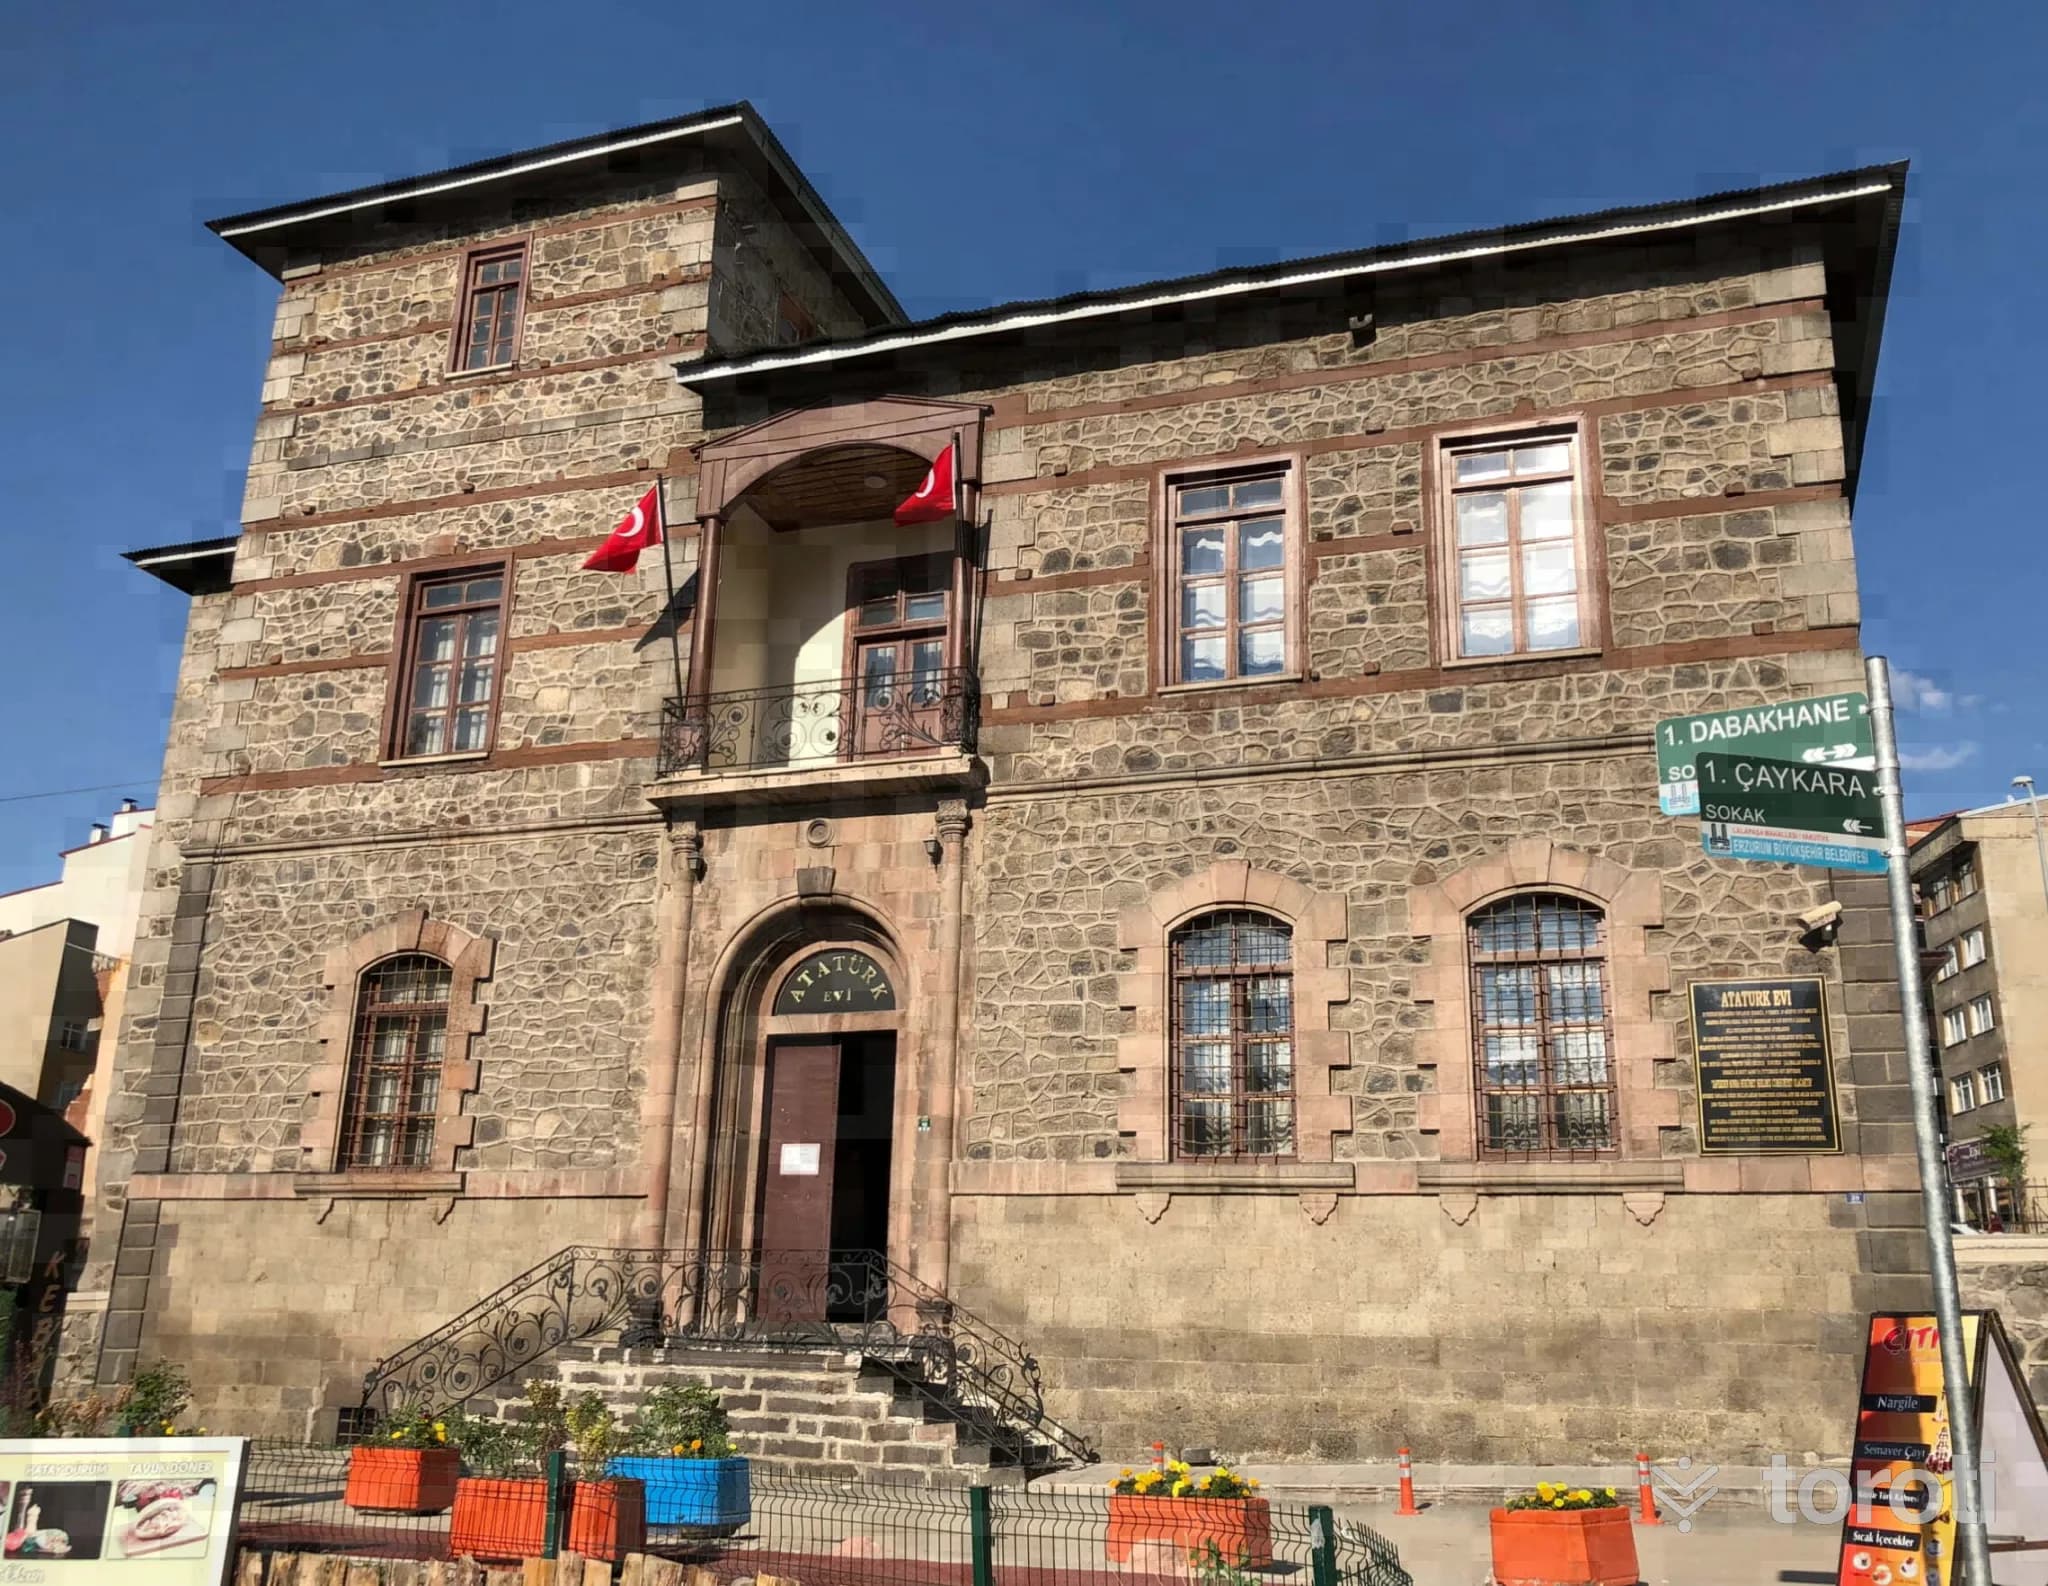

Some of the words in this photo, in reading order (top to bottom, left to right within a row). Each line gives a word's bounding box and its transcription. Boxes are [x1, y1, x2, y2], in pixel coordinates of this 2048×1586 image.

[1664, 725, 1684, 746] 1.
[1690, 699, 1851, 743] DABAKHANE
[1704, 760, 1726, 784] 1.
[1735, 763, 1867, 798] ÇAYKARA
[1706, 804, 1767, 824] SOKAK
[1733, 839, 1772, 854] ERZURUM
[1773, 840, 1824, 860] BÜYÜKŞEHİR
[790, 954, 888, 1003] ATATÜRK
[1877, 1395, 1918, 1411] Nargile
[1863, 1444, 1902, 1457] Semaver
[1853, 1530, 1874, 1544] Sıcak
[1876, 1530, 1915, 1547] İçecekler
